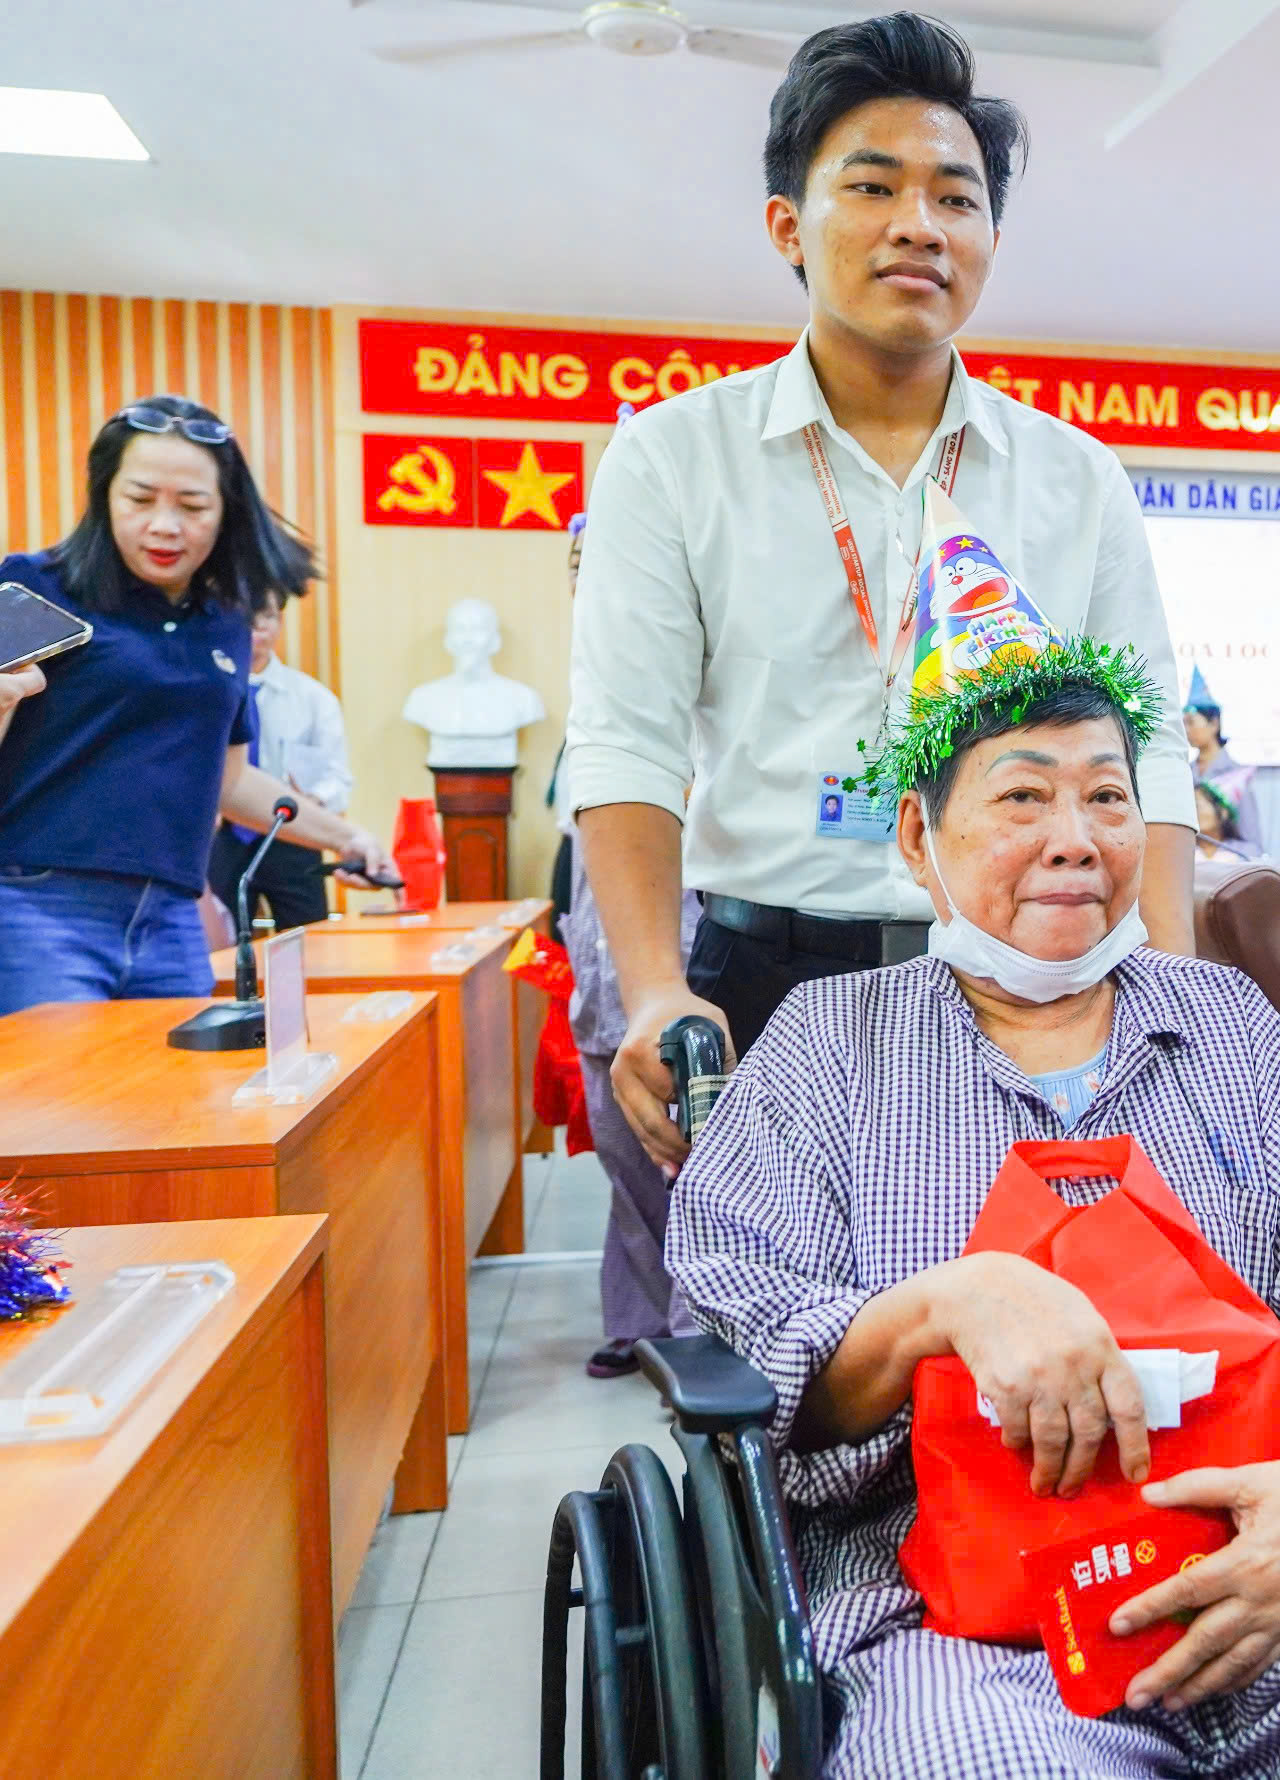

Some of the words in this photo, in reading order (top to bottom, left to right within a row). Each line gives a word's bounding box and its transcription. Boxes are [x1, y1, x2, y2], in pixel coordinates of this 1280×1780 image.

[414, 333, 590, 399] ĐẢNG
[1059, 380, 1179, 428] NAM
[815, 441, 826, 466] Sciences
[824, 467, 832, 479] and
[828, 479, 841, 515] Humanities
[1188, 479, 1237, 510] DÂN
[851, 553, 862, 578] STARTUP
[970, 611, 1028, 637] HAPPY
